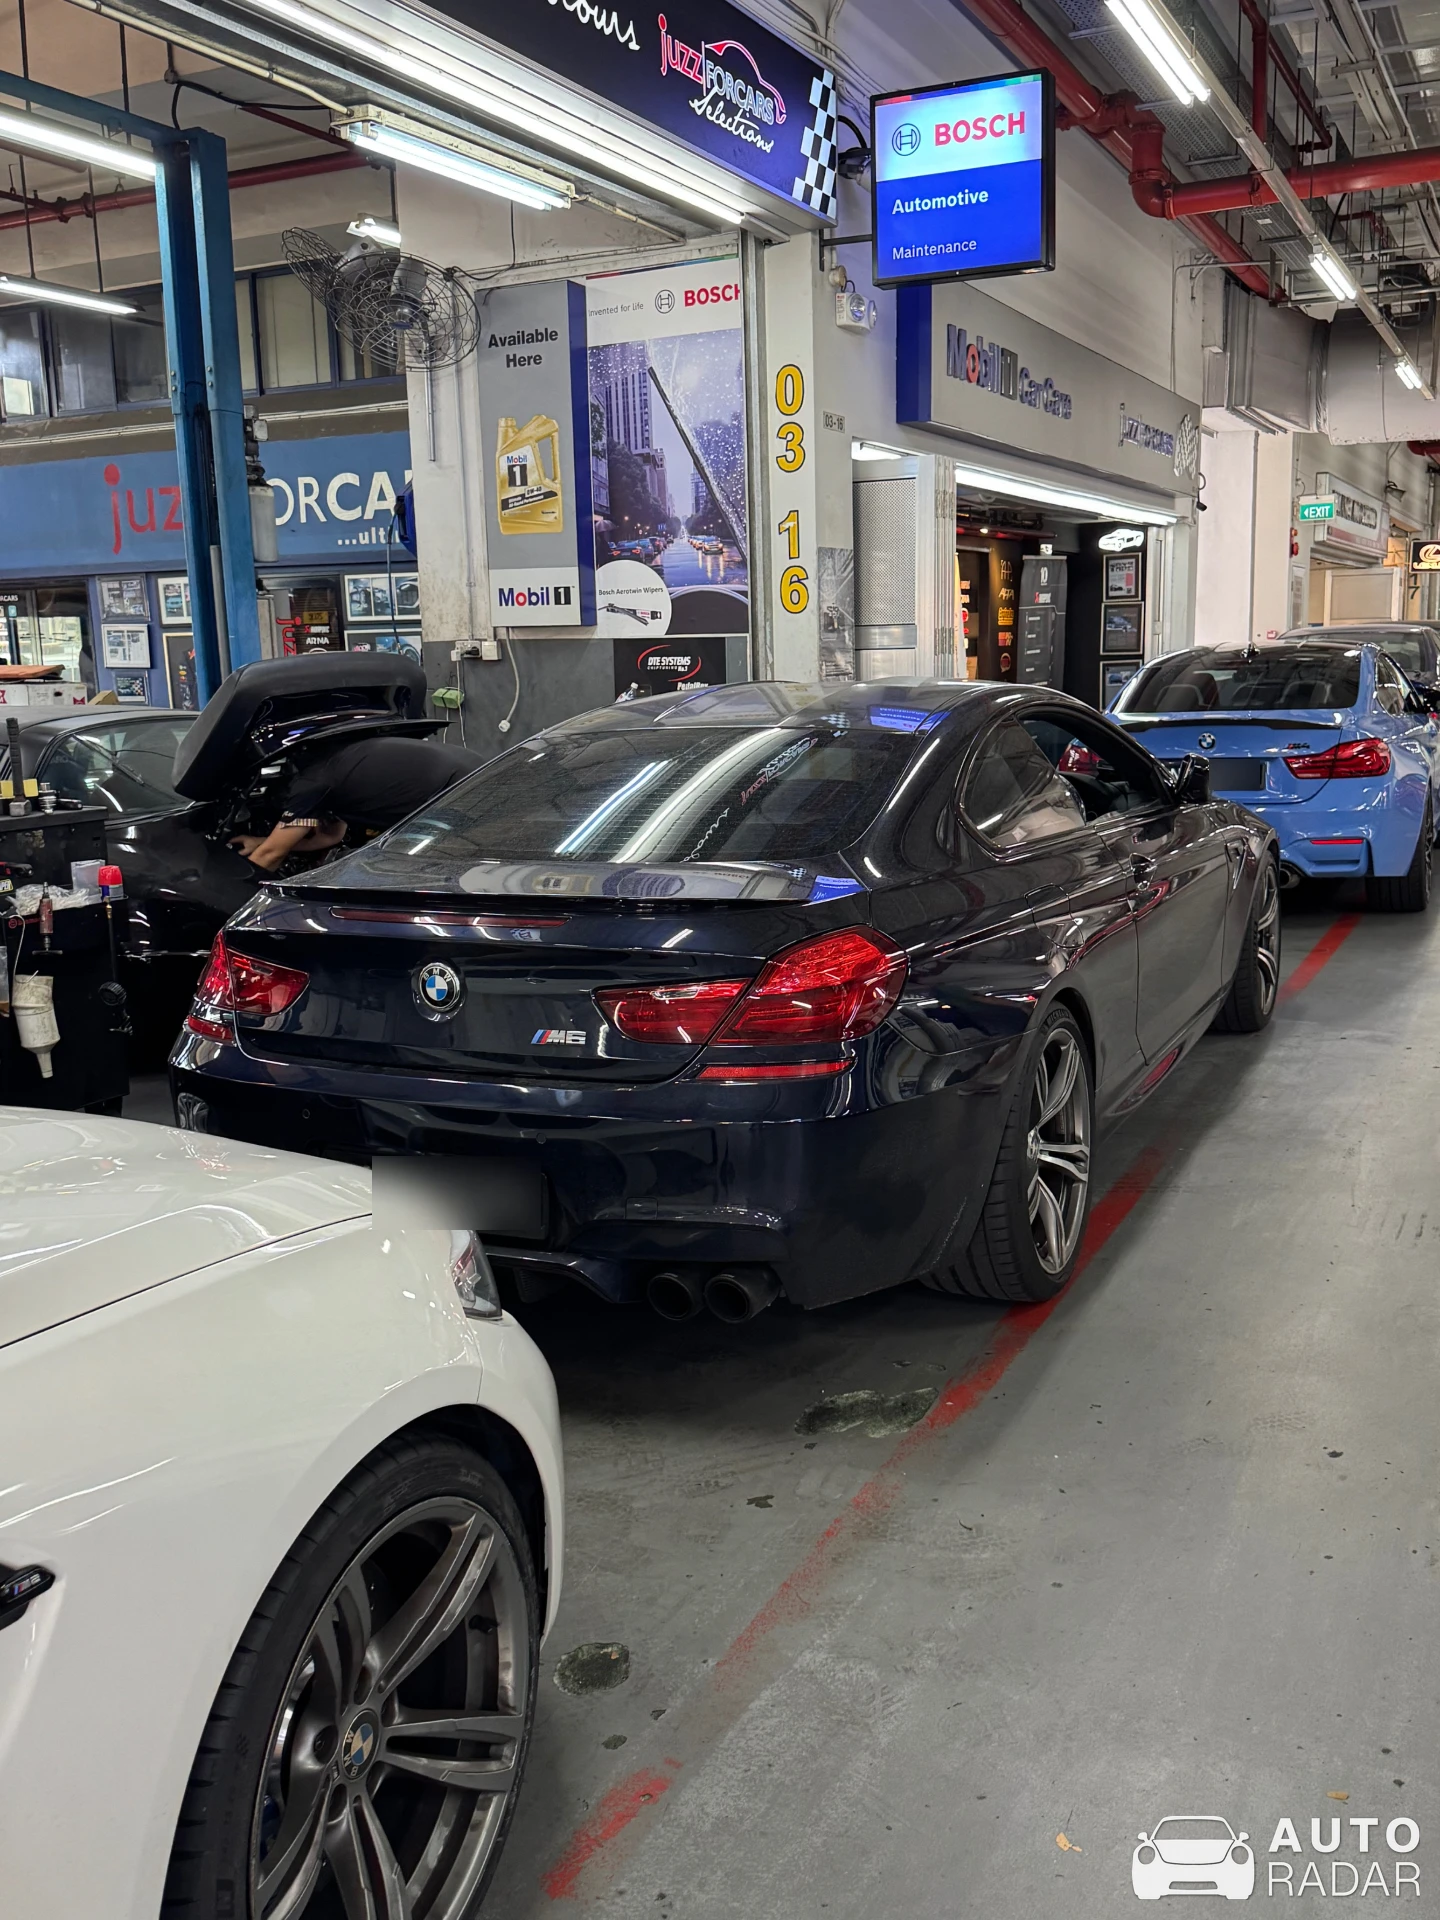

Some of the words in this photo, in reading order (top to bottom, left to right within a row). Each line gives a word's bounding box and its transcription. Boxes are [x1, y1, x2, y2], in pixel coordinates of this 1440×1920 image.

[549, 0, 640, 50] ours
[658, 14, 703, 84] juzz
[706, 60, 775, 125] FORCARS
[689, 86, 774, 153] Selections
[935, 111, 1025, 146] BOSCH
[892, 189, 989, 215] Automotive
[892, 240, 977, 260] Maintenance
[620, 303, 630, 312] for
[632, 302, 644, 311] life
[488, 328, 558, 348] Available
[506, 353, 542, 368] Here
[946, 323, 999, 394] Mobil
[825, 414, 844, 431] 03-16
[506, 455, 527, 464] Mobil
[511, 465, 524, 486] 1
[104, 463, 184, 555] juz
[267, 470, 412, 526] ORCA
[1309, 506, 1331, 518] EXIT
[498, 587, 550, 606] Mobil
[556, 587, 568, 605] 1
[616, 587, 642, 595] Aerotwin
[643, 586, 664, 594] Wipers
[275, 616, 303, 657] juz
[648, 656, 661, 665] DTE
[661, 656, 691, 666] SYSTEMS
[545, 1029, 587, 1045] M6
